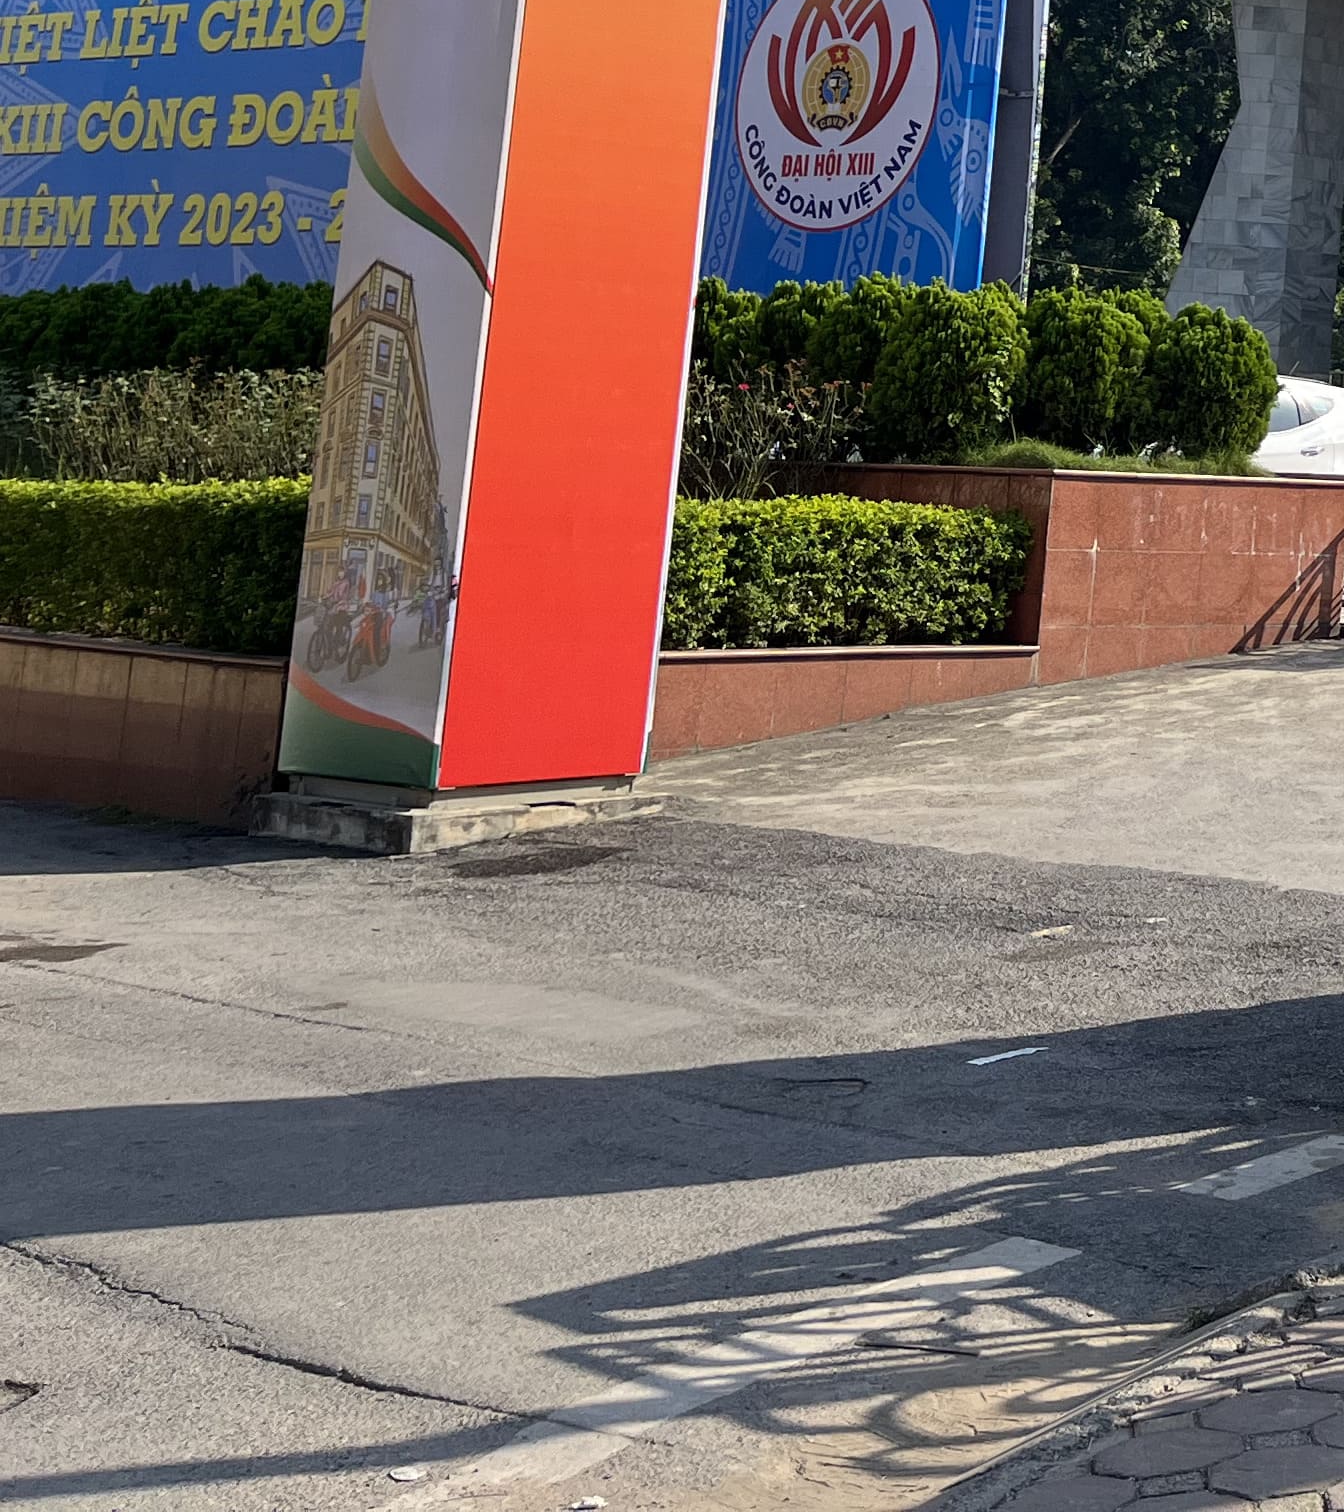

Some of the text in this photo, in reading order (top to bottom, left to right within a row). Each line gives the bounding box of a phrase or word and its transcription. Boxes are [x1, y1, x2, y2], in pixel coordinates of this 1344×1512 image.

[77, 85, 217, 153] CÔNG
[745, 119, 922, 219] CÔNG ĐOÀN VIỆT NAM
[781, 149, 875, 182] ĐẠI HỘI XIII
[104, 179, 174, 248] KỲ
[179, 191, 285, 247] 2023
